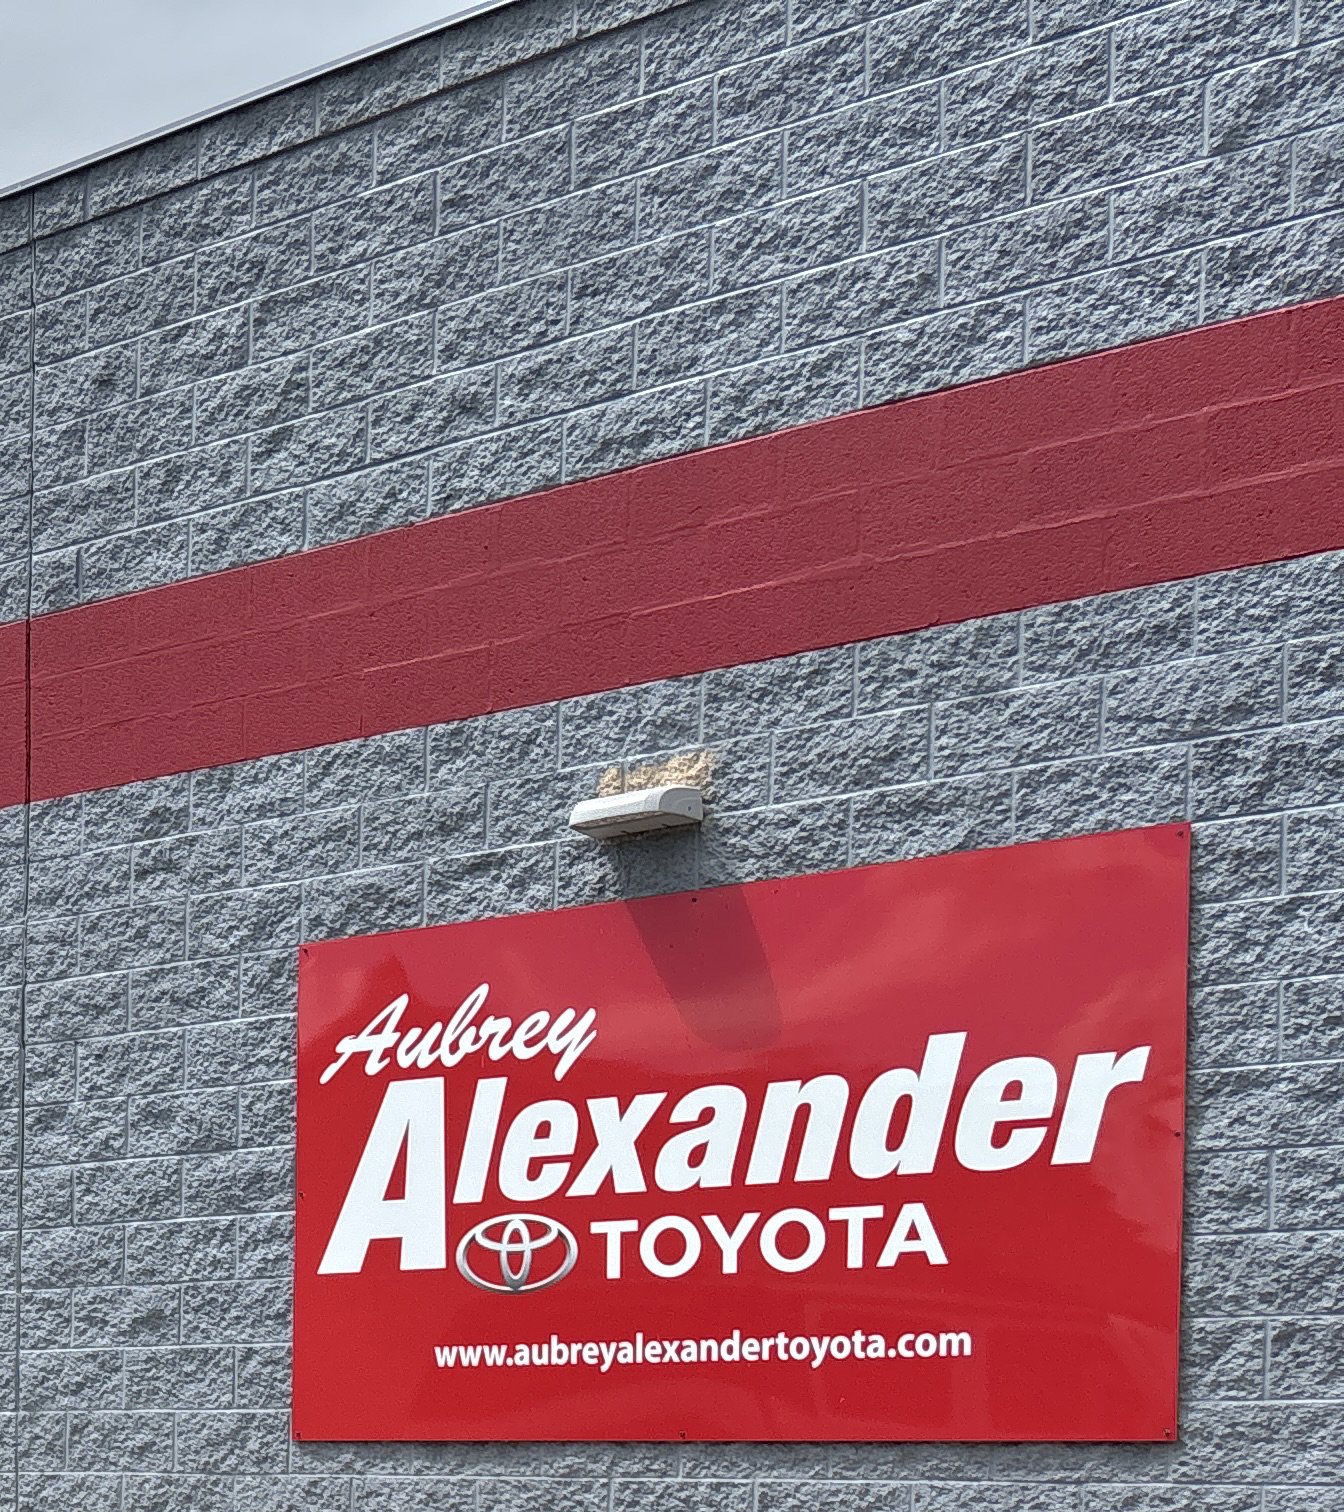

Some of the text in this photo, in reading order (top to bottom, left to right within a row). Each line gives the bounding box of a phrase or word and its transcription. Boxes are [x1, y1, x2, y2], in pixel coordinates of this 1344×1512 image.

[319, 982, 598, 1083] Aubrey
[316, 1031, 1152, 1275] Alexander
[589, 1202, 949, 1280] TOYOTA
[433, 1329, 972, 1373] www.aubreyalexandertoyota.com
